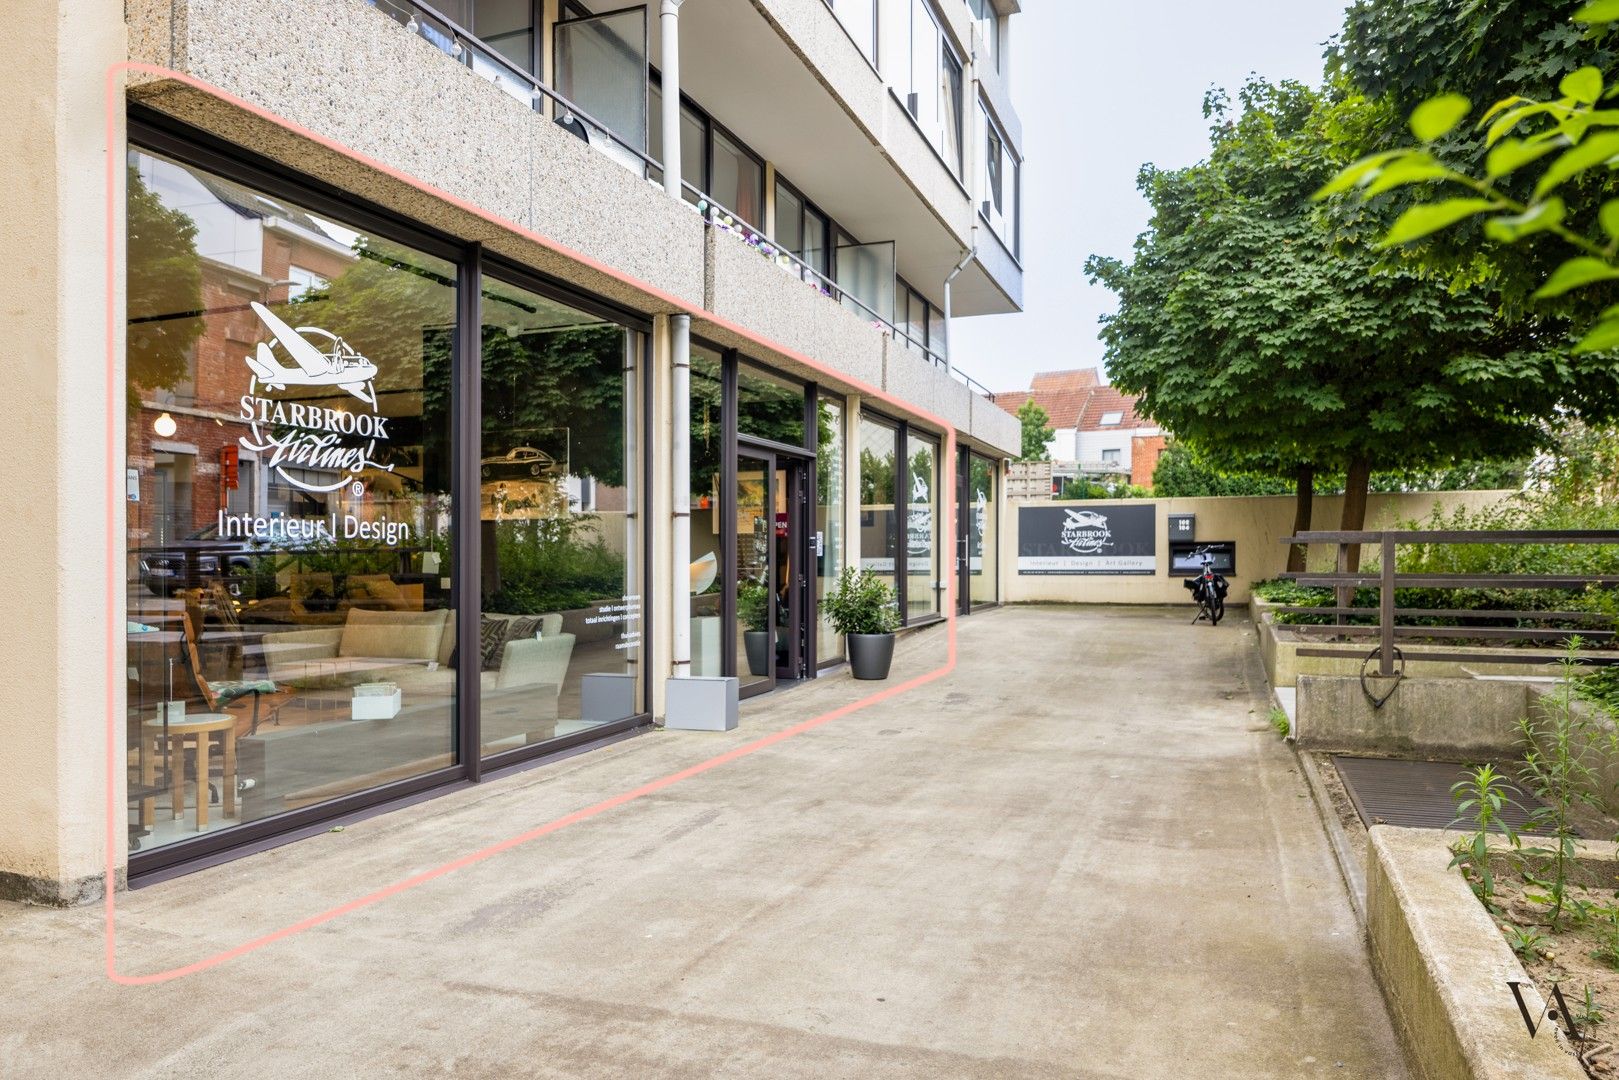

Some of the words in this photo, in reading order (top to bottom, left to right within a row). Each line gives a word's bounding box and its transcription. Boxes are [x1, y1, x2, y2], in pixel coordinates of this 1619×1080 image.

[240, 396, 389, 439] STARBROOK
[219, 509, 325, 538] Interieur
[345, 515, 409, 545] Design
[1061, 530, 1111, 538] STARBROOK
[1071, 560, 1093, 568] Design
[1118, 560, 1144, 568] Gallery
